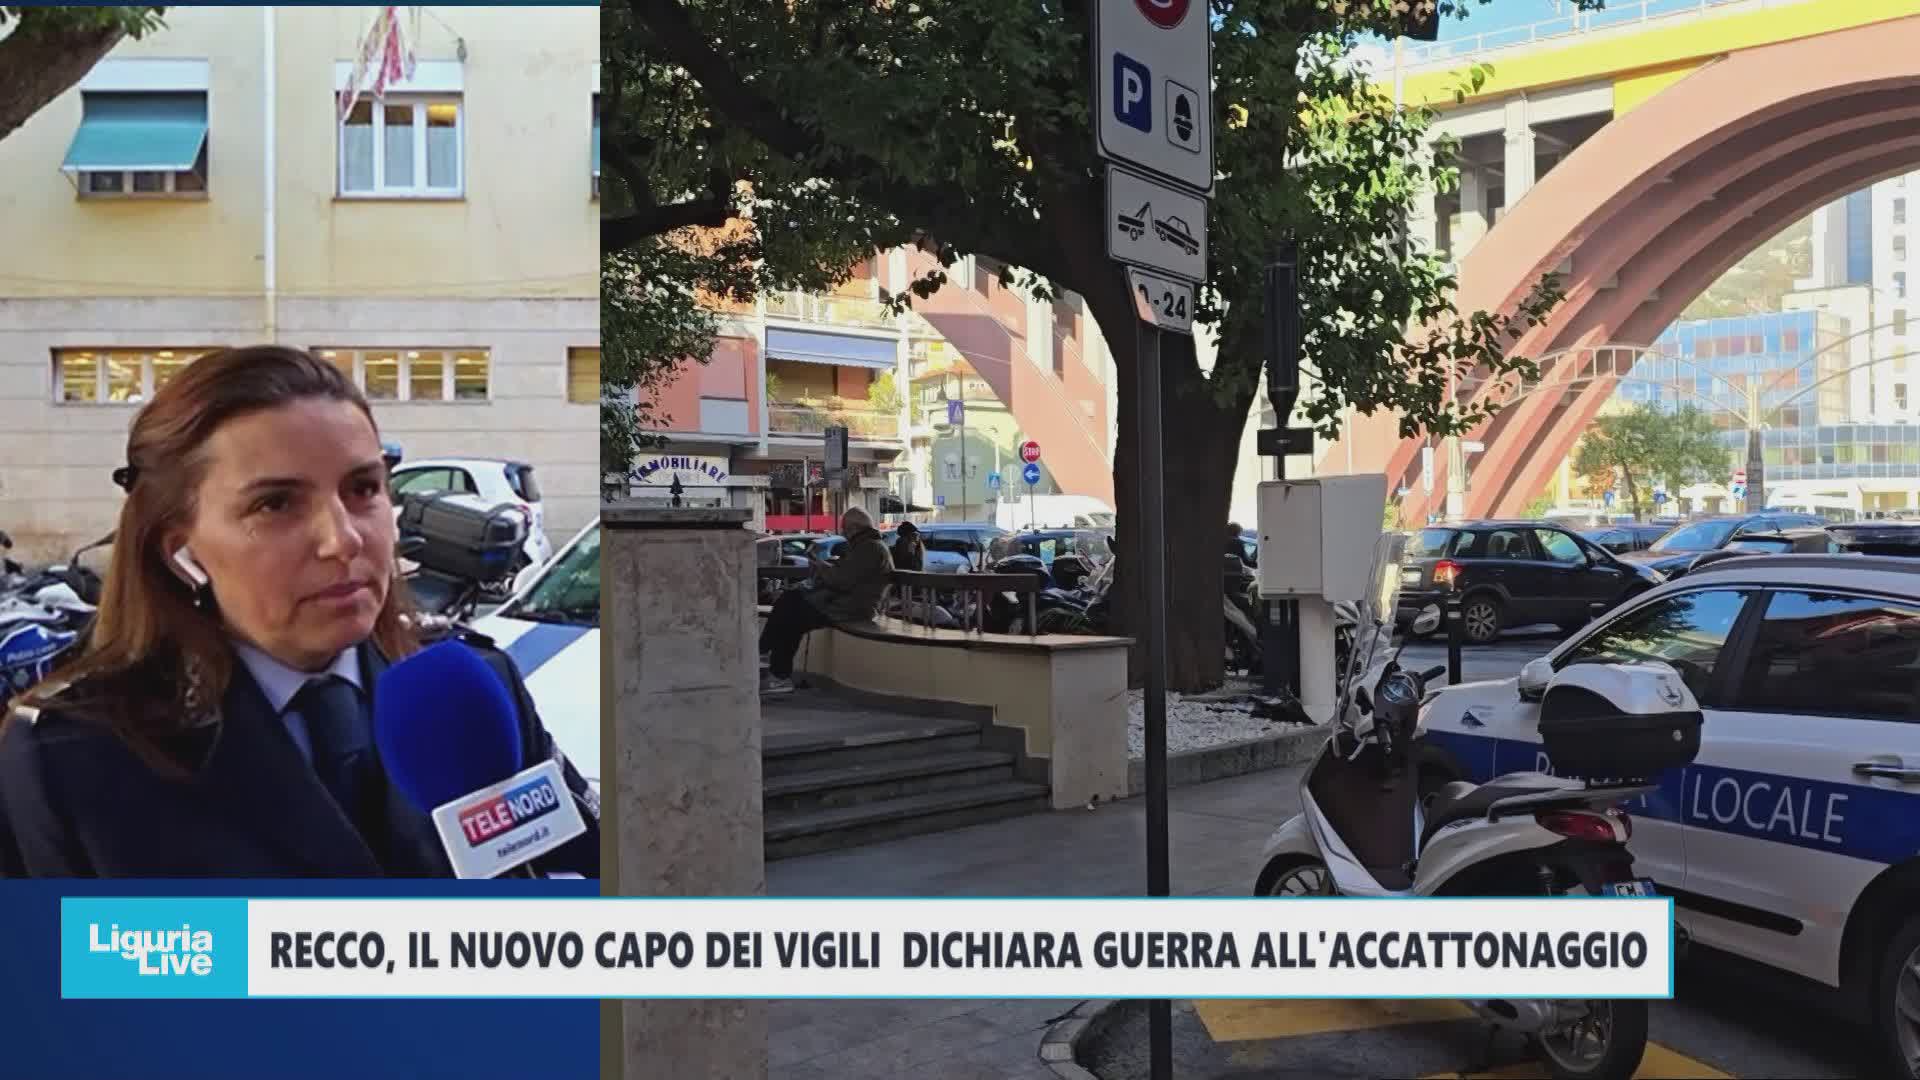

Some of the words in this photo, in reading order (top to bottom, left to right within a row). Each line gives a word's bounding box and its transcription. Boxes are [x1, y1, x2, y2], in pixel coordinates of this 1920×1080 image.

[1122, 68, 1144, 114] P
[1024, 446, 1041, 458] STOP
[1693, 773, 1849, 843] LOCALE
